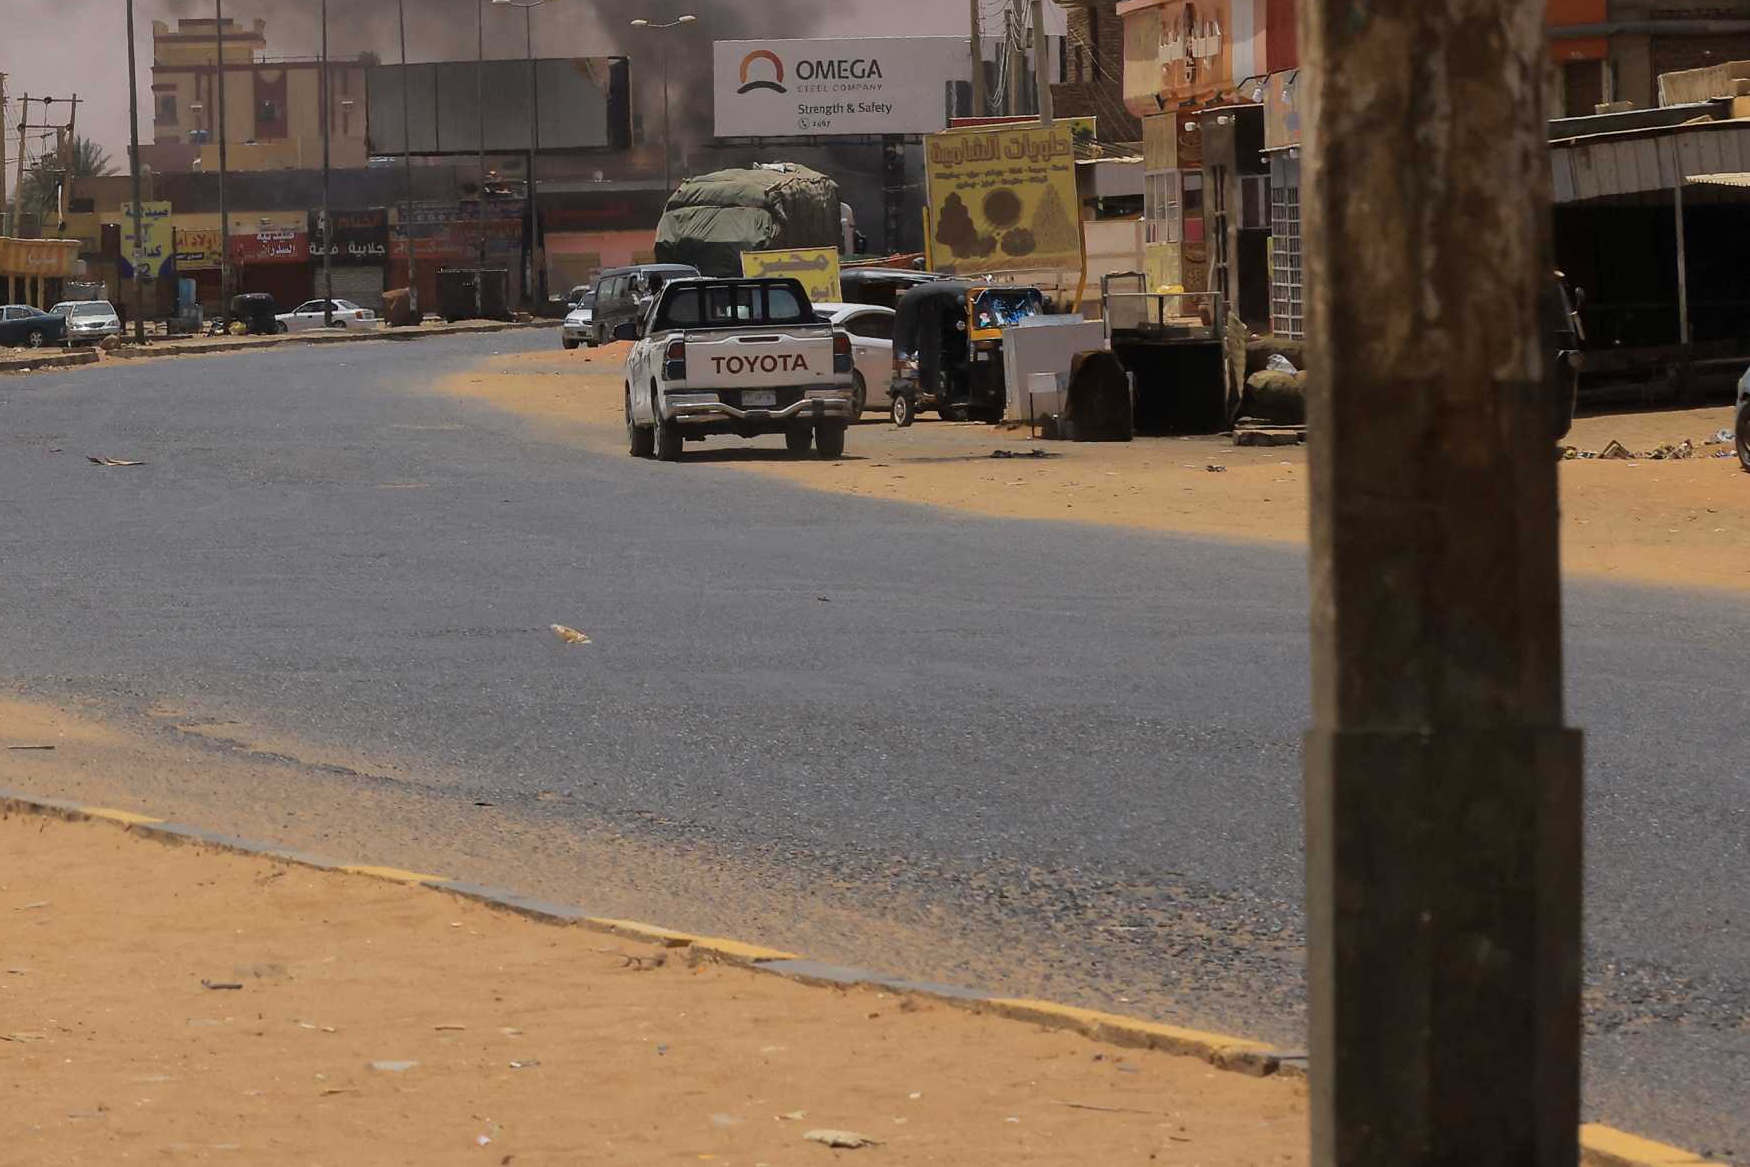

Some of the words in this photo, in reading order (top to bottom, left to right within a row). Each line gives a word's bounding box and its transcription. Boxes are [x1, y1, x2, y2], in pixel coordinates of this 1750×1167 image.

[795, 59, 883, 80] OMEGA
[797, 84, 828, 94] STEEL
[832, 83, 883, 93] COMPANY
[798, 102, 844, 116] Strength
[847, 102, 855, 114] &
[858, 100, 893, 115] Safety
[1004, 130, 1070, 163] حلويات
[711, 353, 809, 375] TOYOTA
